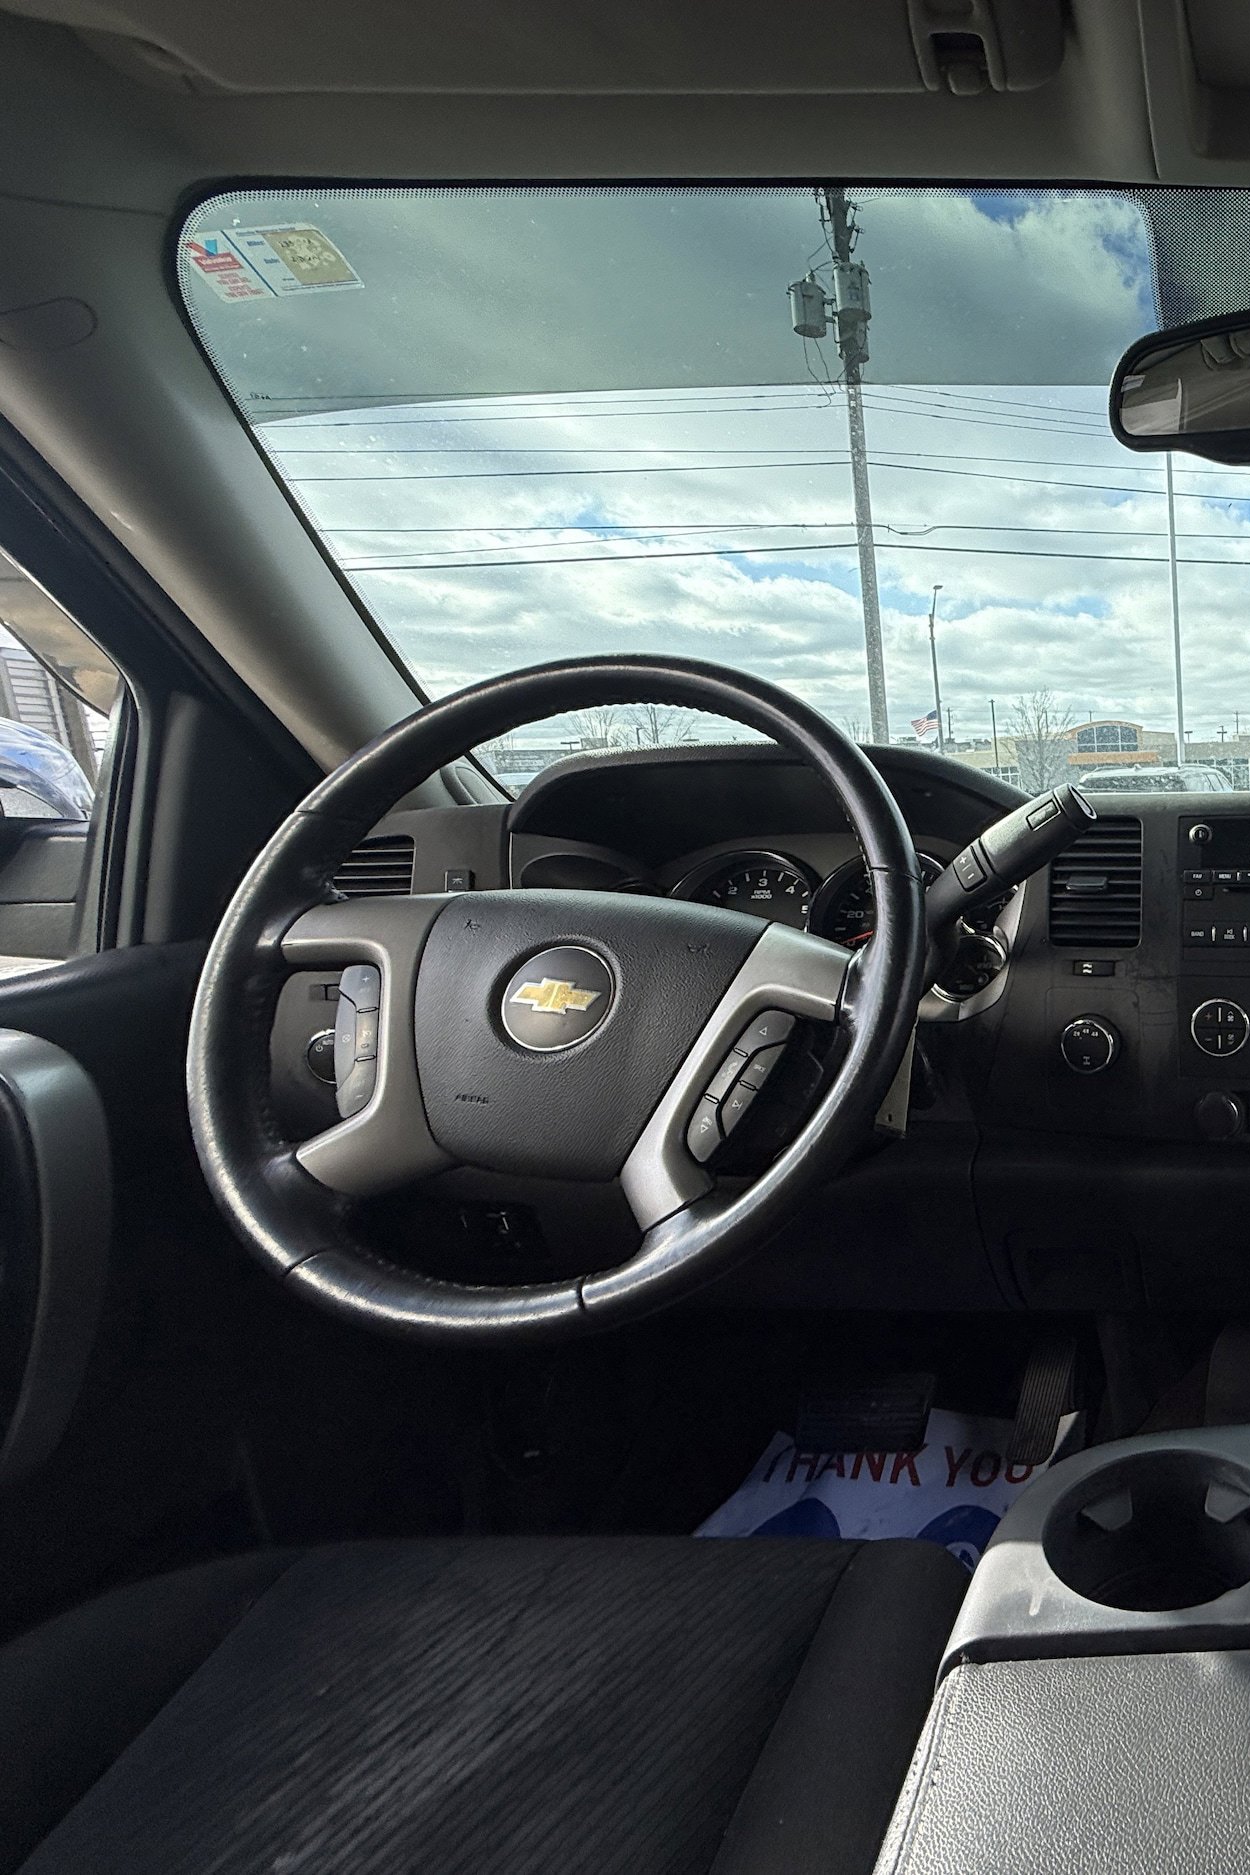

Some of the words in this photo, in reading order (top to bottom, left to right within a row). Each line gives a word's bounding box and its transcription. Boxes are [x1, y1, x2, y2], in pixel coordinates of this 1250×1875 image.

[757, 877, 769, 888] 3
[727, 885, 738, 896] 2
[784, 884, 796, 895] 4
[847, 910, 864, 919] 20
